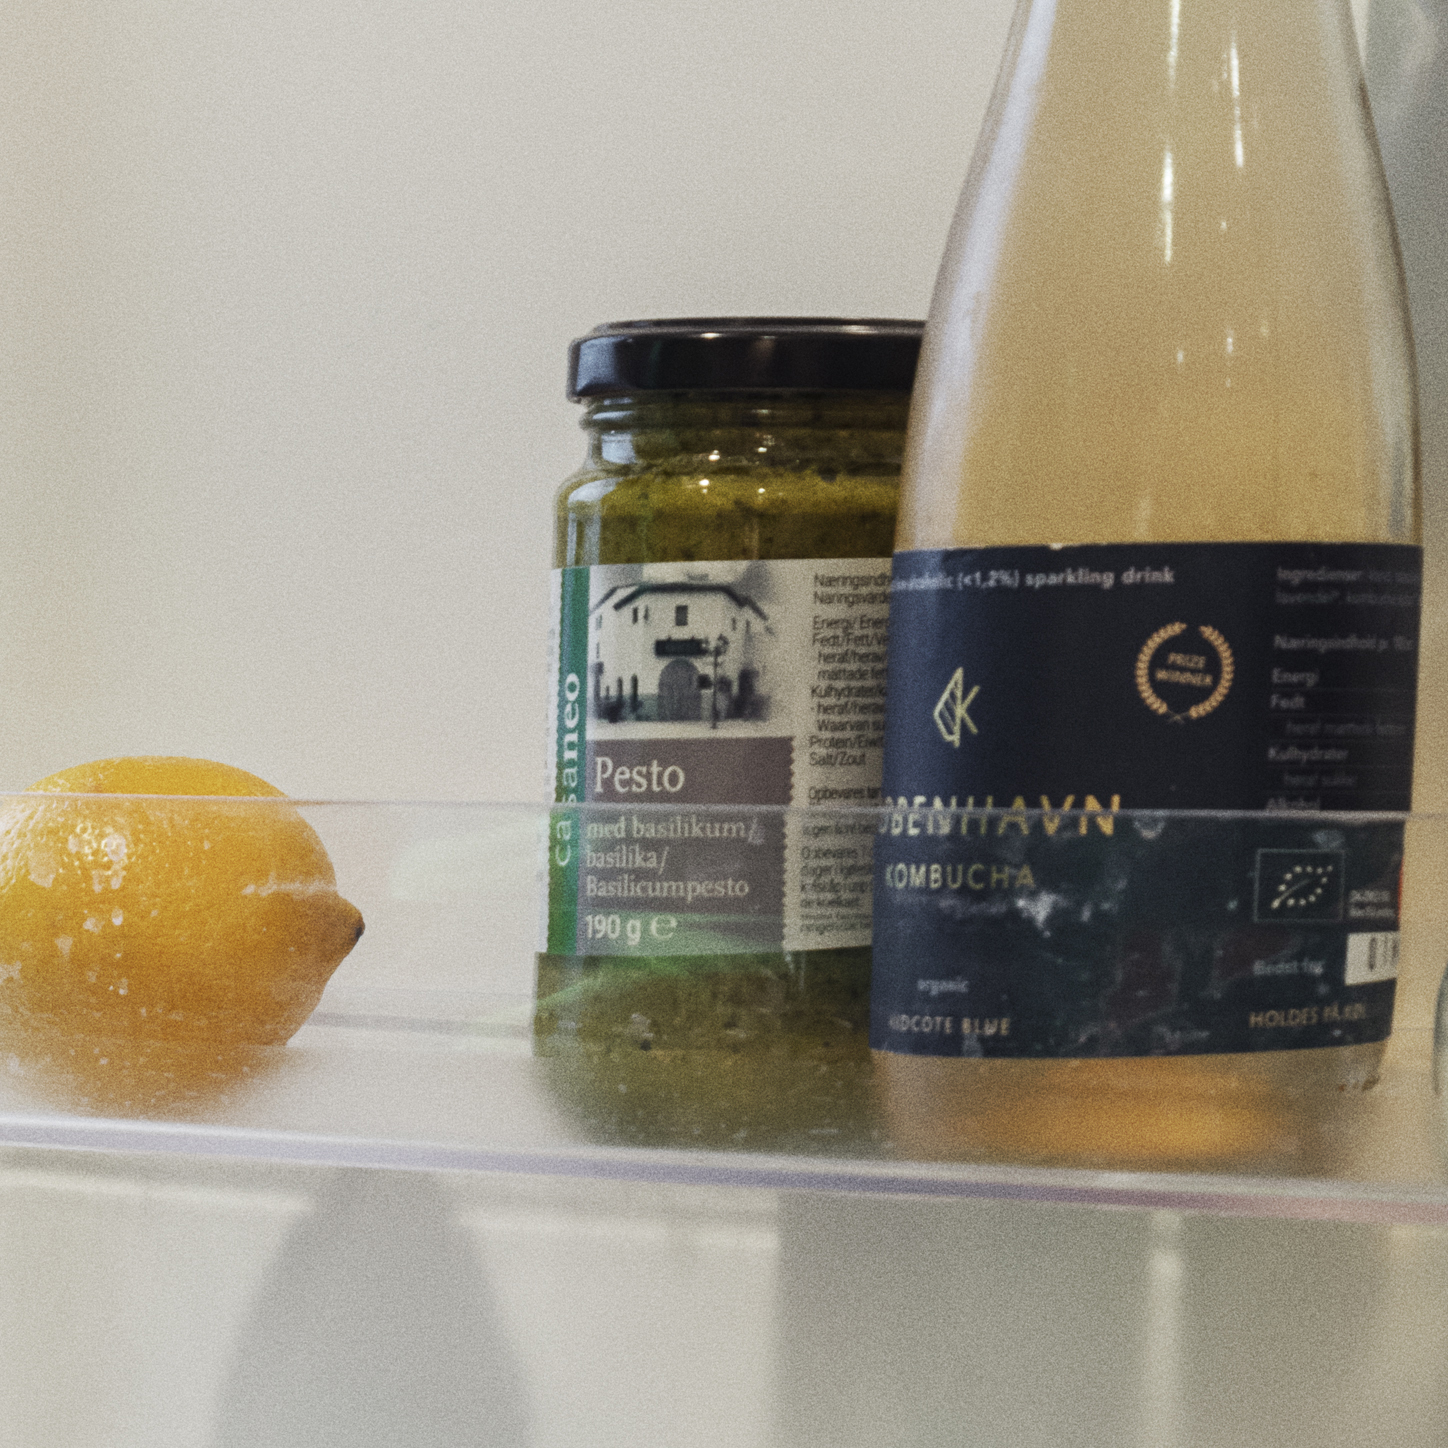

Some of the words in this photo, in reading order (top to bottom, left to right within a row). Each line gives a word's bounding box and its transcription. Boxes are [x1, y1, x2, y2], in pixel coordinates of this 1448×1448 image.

[1025, 567, 1115, 591] sparkling
[1121, 565, 1176, 586] drink
[1271, 668, 1320, 687] Energi
[1269, 693, 1307, 711] Fedt
[594, 756, 686, 793] Pesto
[586, 815, 626, 838] med
[586, 844, 670, 875] basilika/
[586, 873, 751, 905] Basilicumpesto
[885, 861, 1037, 891] KOMBUCHA
[586, 913, 621, 939] 190
[625, 916, 642, 946] g
[917, 976, 970, 997] organic
[1249, 1005, 1319, 1029] HOLDES
